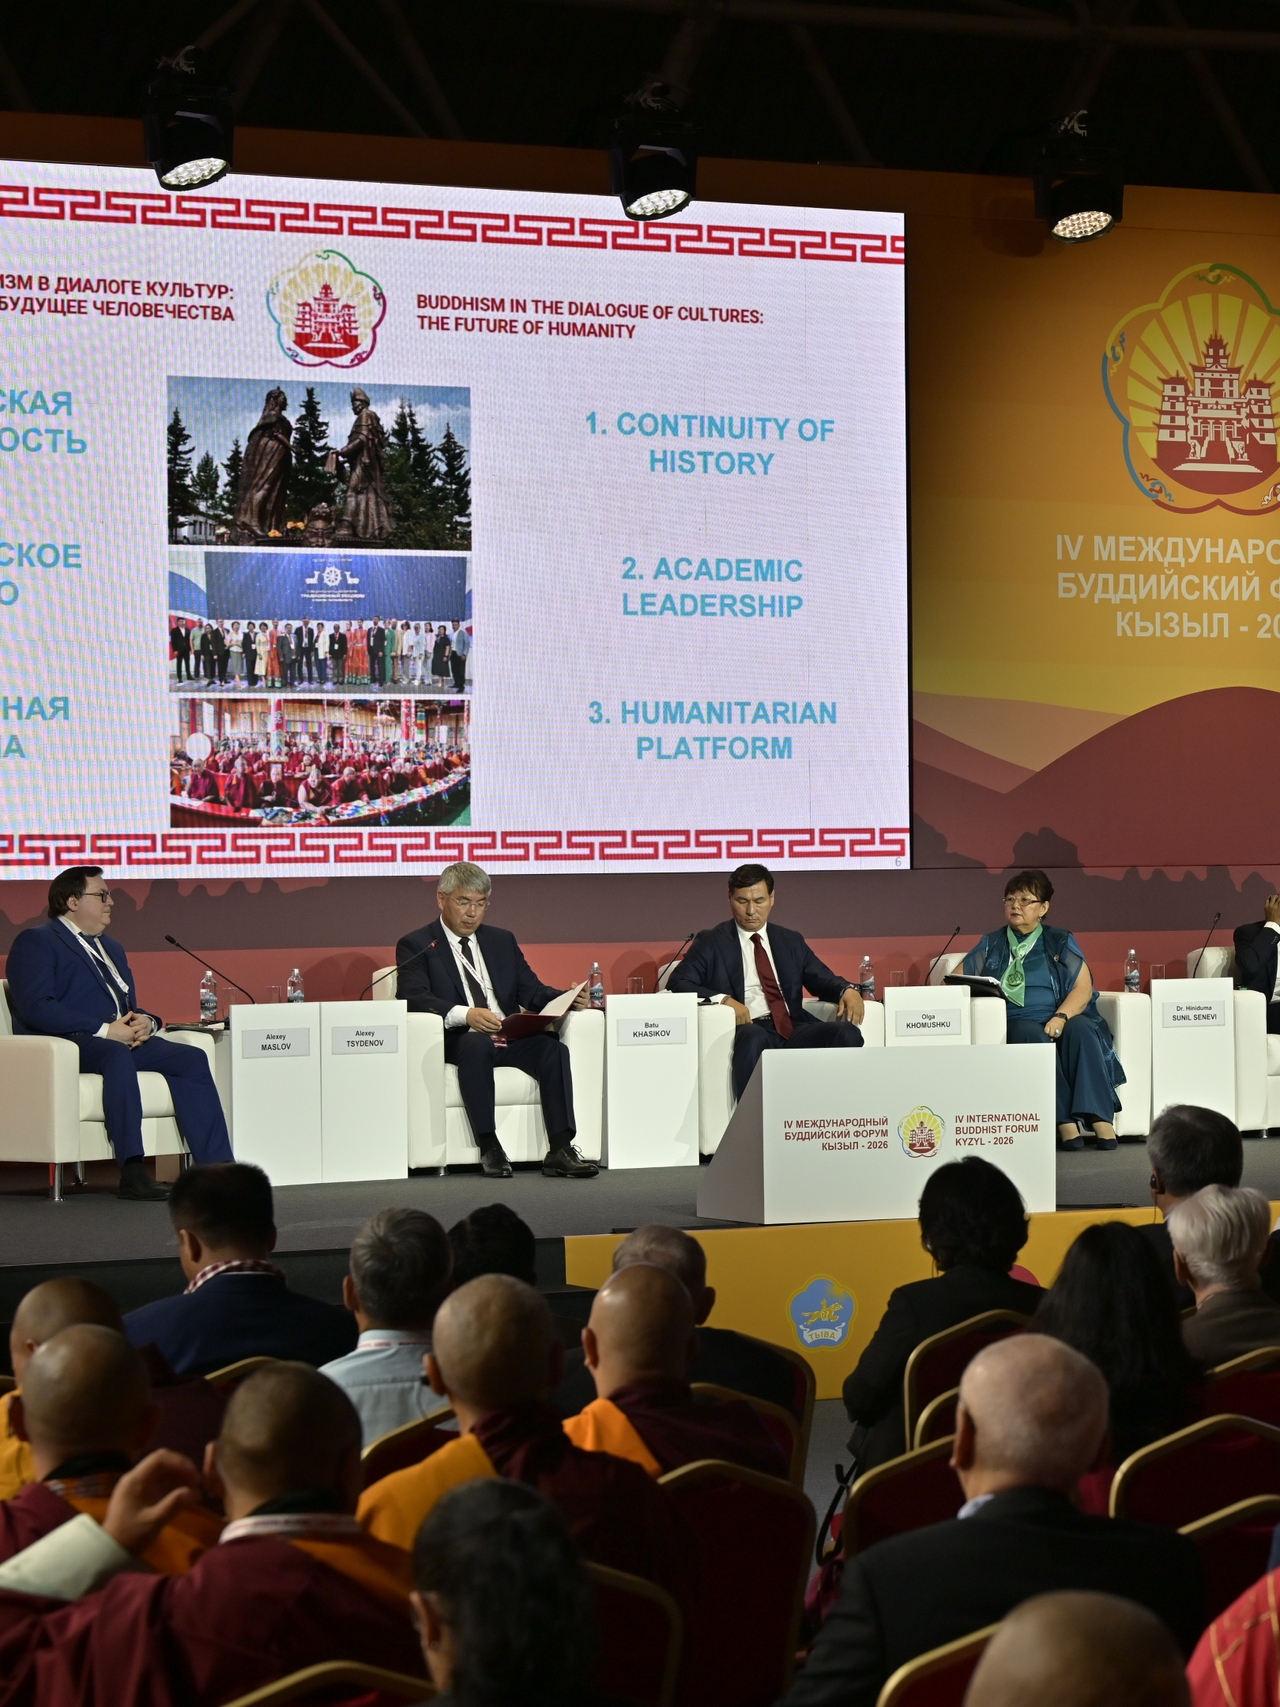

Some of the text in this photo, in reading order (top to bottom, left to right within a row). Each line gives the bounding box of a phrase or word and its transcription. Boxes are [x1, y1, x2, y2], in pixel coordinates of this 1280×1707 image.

[39, 276, 49, 291] В
[55, 277, 141, 295] ДИАЛОГЕ
[147, 281, 233, 299] КУЛЬТУР:
[0, 296, 234, 321] БУДУЩЕЕ ЧЕЛОВЕЧЕСТВА
[417, 294, 763, 323] BUDDHISM IN THE DIALOGUE OF CULTURES:
[417, 315, 635, 338] THE FUTURE OF HUMANITY
[0, 389, 72, 416] КАЯ
[586, 412, 834, 441] 1. CONTINUITY OF
[0, 427, 87, 454] ОСТЬ
[650, 450, 774, 475] HISTORY
[1057, 535, 1084, 560] IV
[622, 557, 802, 582] 2. ACADEMIC
[1059, 569, 1259, 604] БУДДИЙСКИЙ
[623, 593, 803, 617] LEADERSHIP
[1117, 612, 1229, 637] КЫЗЫЛ
[2, 697, 69, 720] НАЯ
[589, 701, 836, 724] 3. HUMANITARIAN
[0, 735, 26, 758] А
[637, 737, 792, 759] PLATFORM
[896, 857, 902, 866] 6
[796, 1118, 888, 1130] МЕЖДУНАРОДНЫЙ
[956, 1124, 1038, 1134] BUDDHIST FORUM
[967, 1113, 1040, 1122] INTERNATIONAL
[785, 1129, 888, 1141] БУДДИЙСКИЙ ФОРУМ
[822, 1142, 858, 1150] КЫЗЫЛ
[868, 1141, 888, 1149] 2026
[956, 1138, 985, 1146] KYZYL
[808, 1331, 836, 1340] ТЫВА
